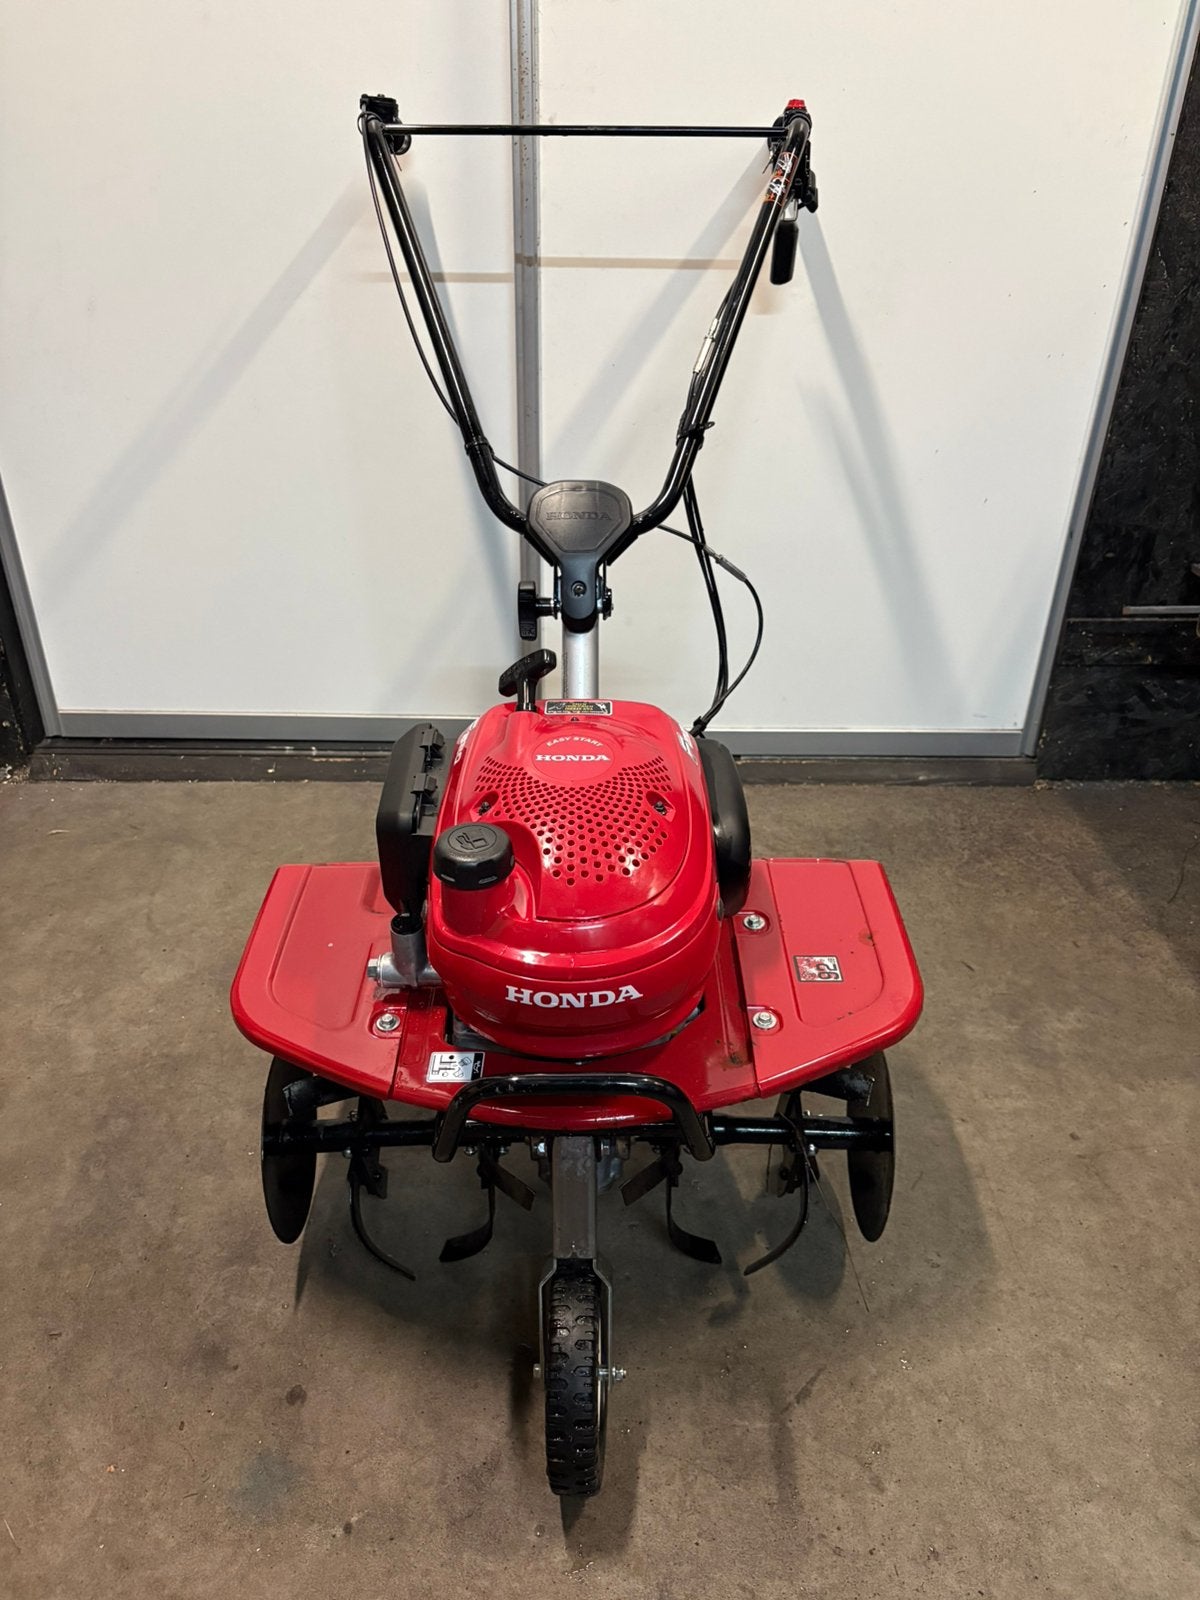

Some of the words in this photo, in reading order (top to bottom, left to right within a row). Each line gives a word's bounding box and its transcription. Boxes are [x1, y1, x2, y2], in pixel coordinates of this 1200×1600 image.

[545, 511, 612, 520] HONDA
[546, 736, 571, 747] EASY
[573, 736, 604, 747] START
[816, 963, 839, 979] 92
[505, 984, 643, 1008] HONDA
